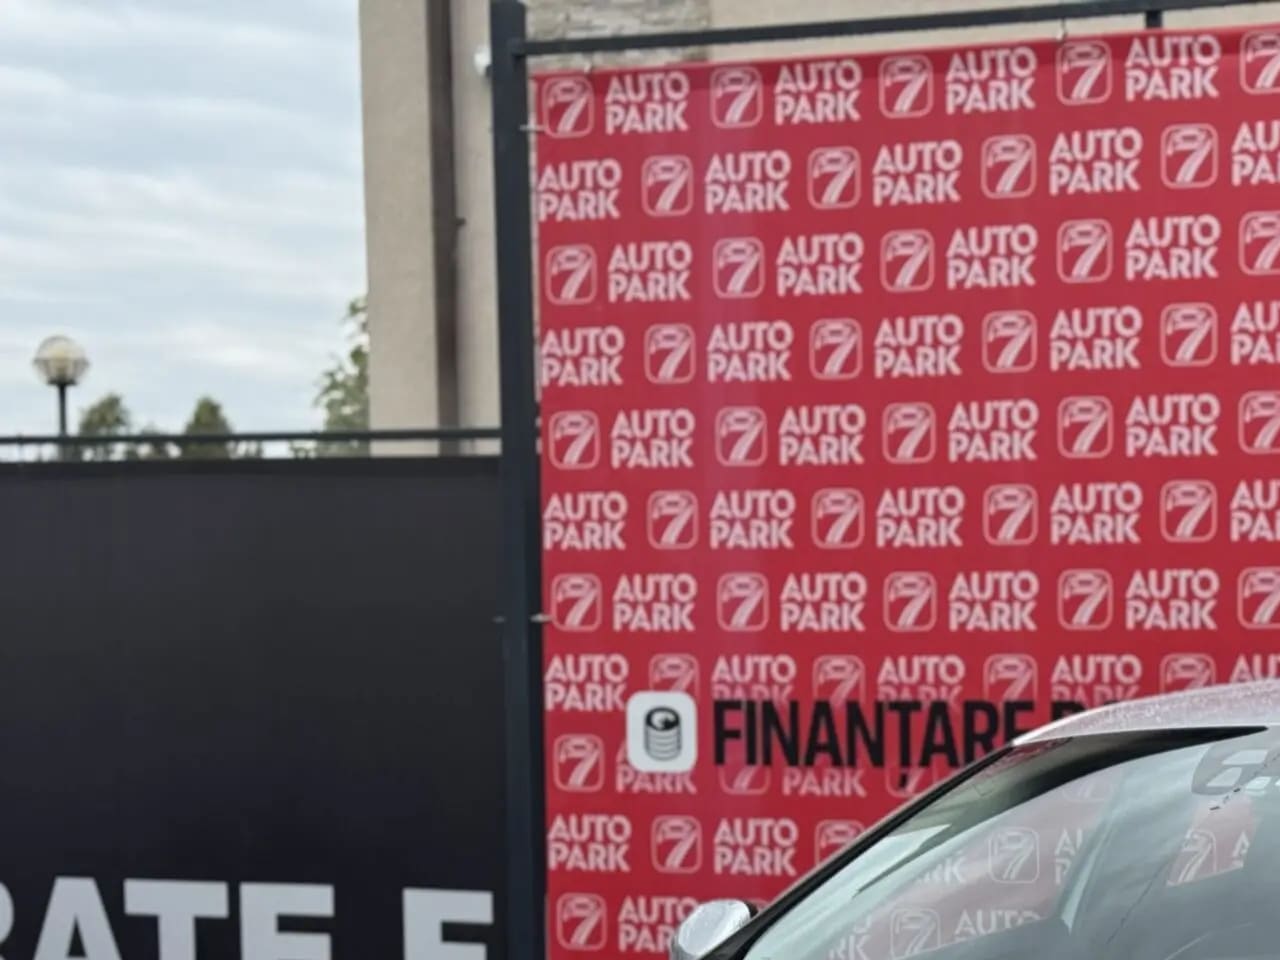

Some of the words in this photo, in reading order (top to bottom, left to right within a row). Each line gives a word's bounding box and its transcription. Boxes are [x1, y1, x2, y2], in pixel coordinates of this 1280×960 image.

[946, 47, 1036, 83] AUTO
[1125, 34, 1220, 69] AUTO
[605, 72, 689, 105] AUTO
[775, 60, 861, 94] AUTO
[1126, 65, 1218, 101] PARK
[775, 89, 860, 125] PARK
[946, 77, 1035, 114] PARK
[606, 100, 688, 134] PARK
[873, 140, 962, 176] AUTO
[1049, 128, 1142, 164] AUTO
[538, 159, 622, 191] AUTO
[705, 150, 791, 184] AUTO
[1050, 159, 1139, 195] PARK
[706, 180, 789, 213] PARK
[873, 171, 960, 206] PARK
[538, 189, 621, 222] PARK
[947, 224, 1037, 259] AUTO
[1126, 214, 1220, 249] AUTO
[608, 241, 692, 273] AUTO
[776, 233, 864, 266] AUTO
[1126, 245, 1217, 280] PARK
[609, 270, 690, 302] PARK
[777, 262, 862, 296] PARK
[947, 254, 1035, 289] PARK
[707, 320, 793, 353] AUTO
[875, 314, 963, 347] AUTO
[1050, 306, 1142, 340] AUTO
[541, 326, 625, 356] AUTO
[1050, 336, 1139, 371] PARK
[541, 354, 624, 387] PARK
[708, 350, 791, 382] PARK
[875, 345, 961, 378] PARK
[611, 409, 695, 440] AUTO
[779, 404, 866, 436] AUTO
[948, 399, 1038, 432] AUTO
[1126, 394, 1220, 426] AUTO
[612, 438, 693, 468] PARK
[780, 434, 863, 465] PARK
[949, 429, 1036, 462] PARK
[1126, 424, 1217, 457] PARK
[543, 492, 627, 521] AUTO
[710, 489, 795, 520] AUTO
[877, 486, 964, 518] AUTO
[1051, 482, 1142, 514] AUTO
[544, 520, 625, 550] PARK
[710, 518, 793, 548] PARK
[877, 516, 962, 547] PARK
[1051, 512, 1139, 544] PARK
[613, 573, 697, 602] AUTO
[781, 572, 867, 602] AUTO
[949, 571, 1039, 602] AUTO
[1126, 569, 1219, 599] AUTO
[613, 602, 694, 631] PARK
[781, 601, 864, 631] PARK
[950, 601, 1036, 631] PARK
[1126, 599, 1216, 629] PARK
[544, 654, 629, 683] AUTO
[712, 654, 797, 684] AUTO
[878, 655, 966, 685] AUTO
[1051, 654, 1142, 684] AUTO
[545, 682, 628, 711] PARK
[783, 768, 867, 797] PARK
[548, 815, 631, 843] AUTO
[713, 818, 798, 847] AUTO
[549, 840, 629, 871] PARK
[714, 846, 797, 876] PARK
